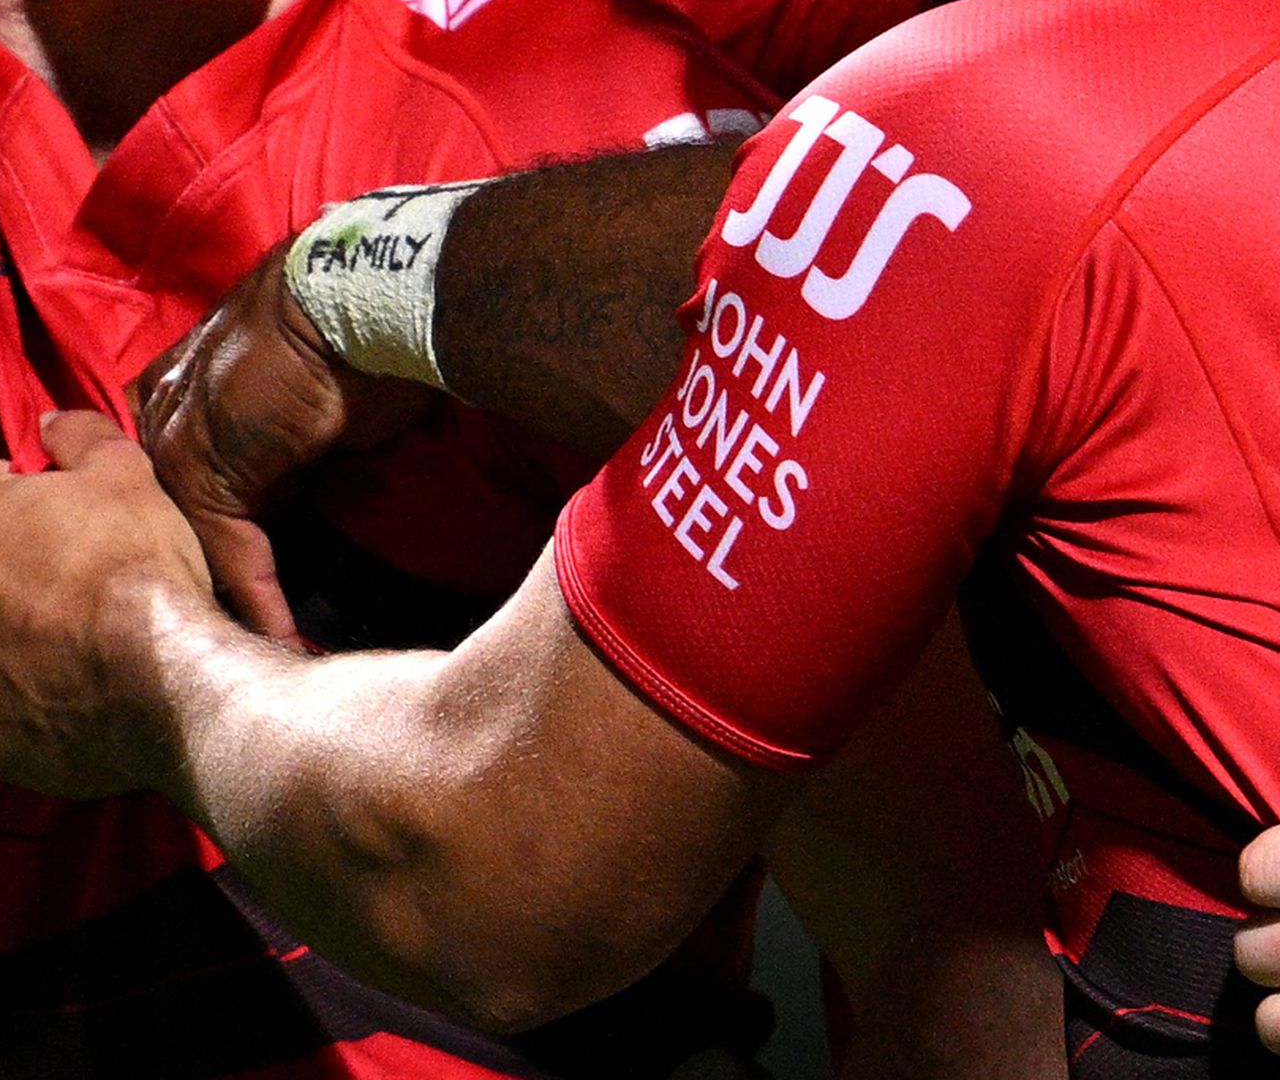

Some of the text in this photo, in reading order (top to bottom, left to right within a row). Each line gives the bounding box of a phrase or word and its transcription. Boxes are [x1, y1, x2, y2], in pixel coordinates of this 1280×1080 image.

[307, 232, 432, 274] FAMILY
[677, 348, 809, 531] JONES
[695, 278, 825, 438] JOHN
[640, 412, 740, 591] STEEL
